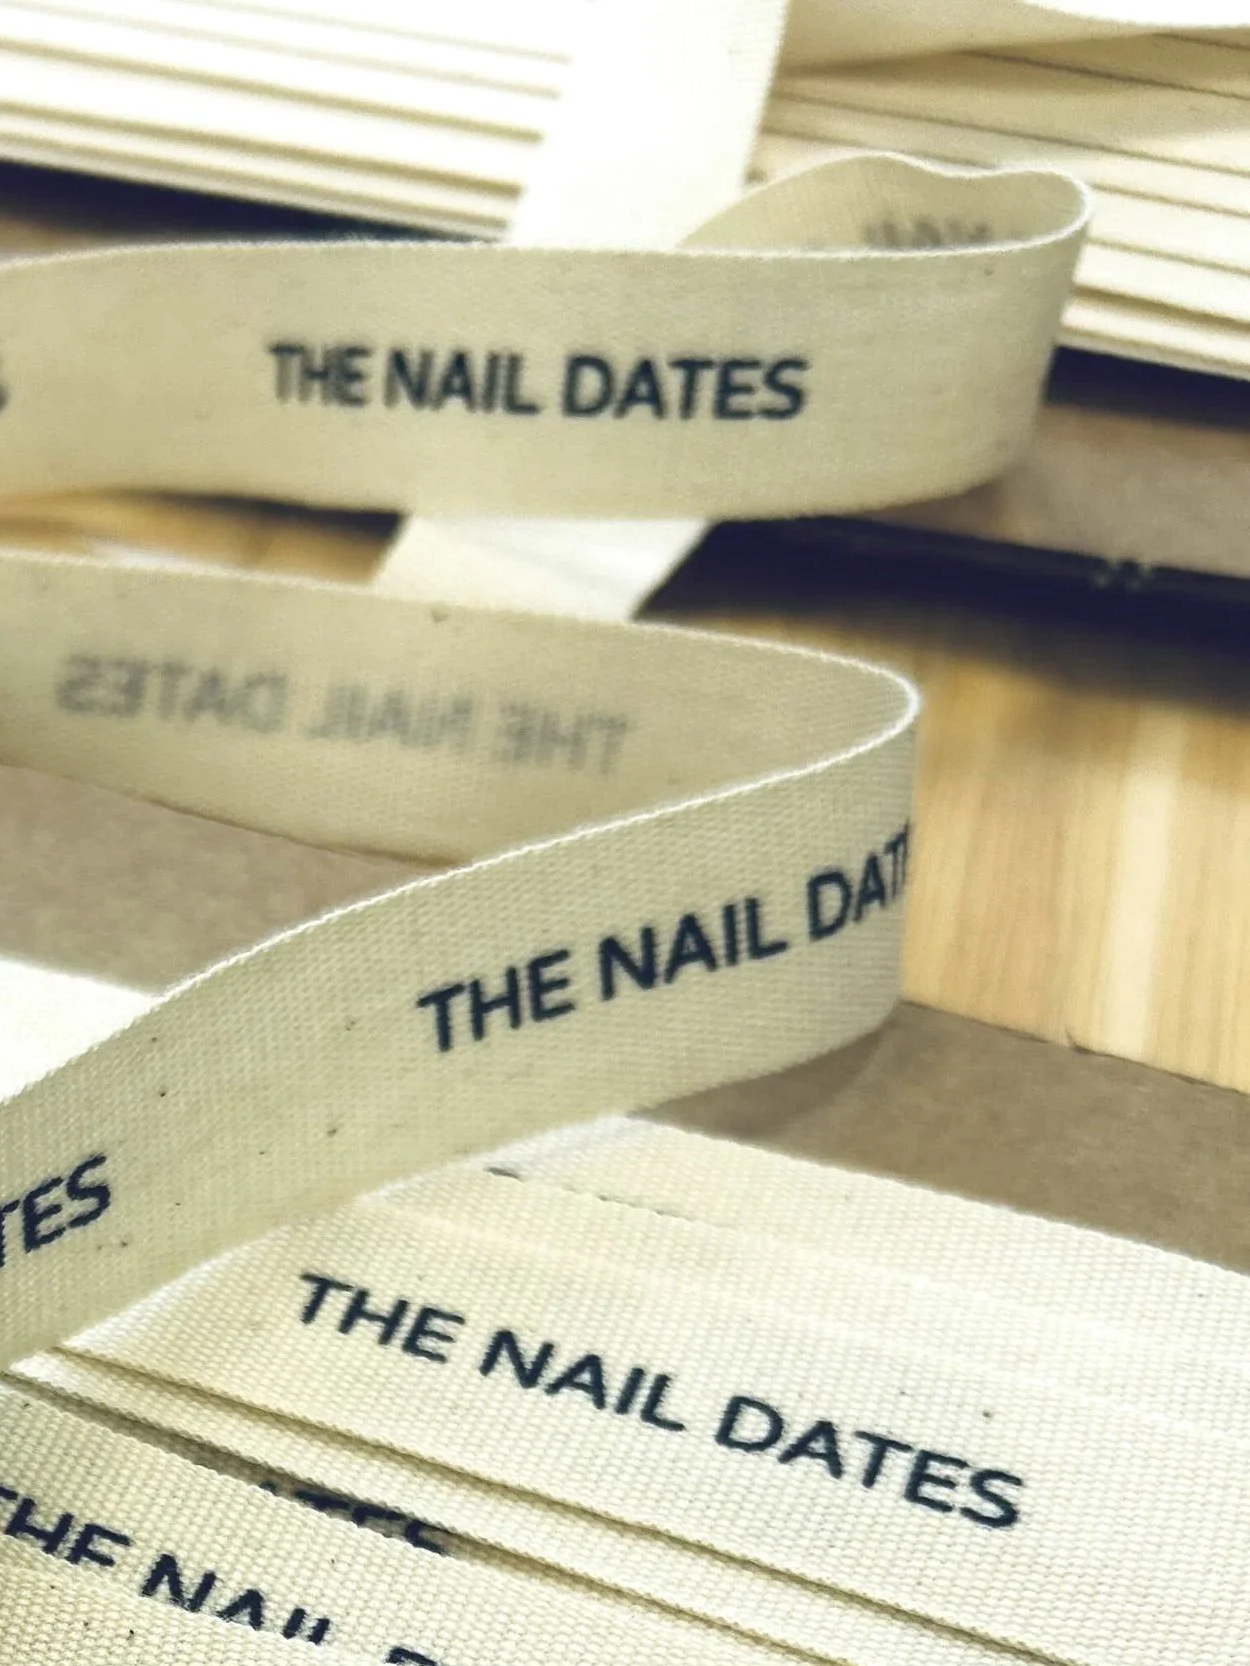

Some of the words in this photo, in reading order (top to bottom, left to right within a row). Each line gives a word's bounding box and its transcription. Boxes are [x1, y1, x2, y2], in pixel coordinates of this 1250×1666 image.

[269, 340, 372, 407] THE
[384, 348, 540, 416] NAIL
[561, 353, 809, 421] DATES
[416, 948, 575, 1053] THE
[598, 897, 789, 1001] NAIL
[300, 1271, 465, 1363] THE
[478, 1328, 686, 1431] NAIL
[713, 1395, 1024, 1529] DATES
